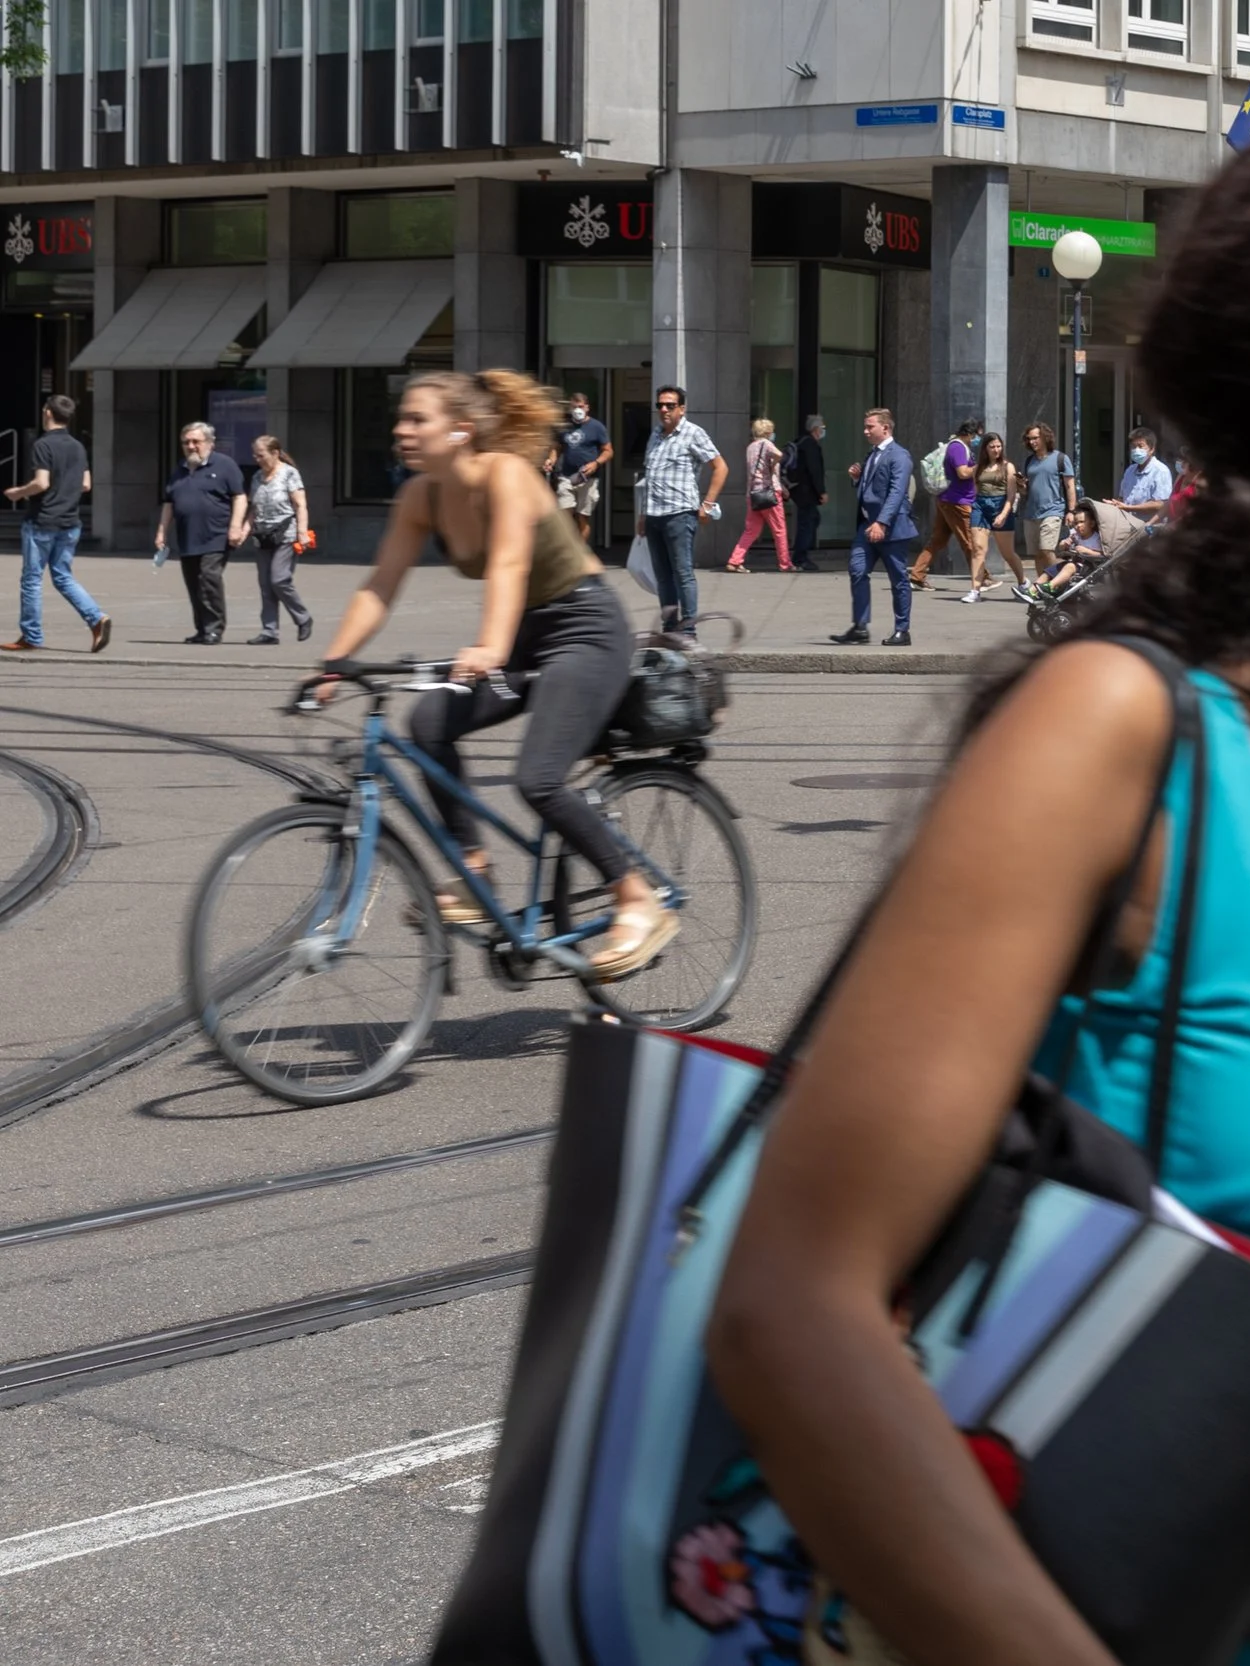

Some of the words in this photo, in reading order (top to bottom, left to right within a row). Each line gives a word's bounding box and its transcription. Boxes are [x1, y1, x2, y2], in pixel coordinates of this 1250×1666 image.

[38, 217, 92, 255] UBS
[618, 202, 655, 240] U
[885, 211, 920, 252] UBS
